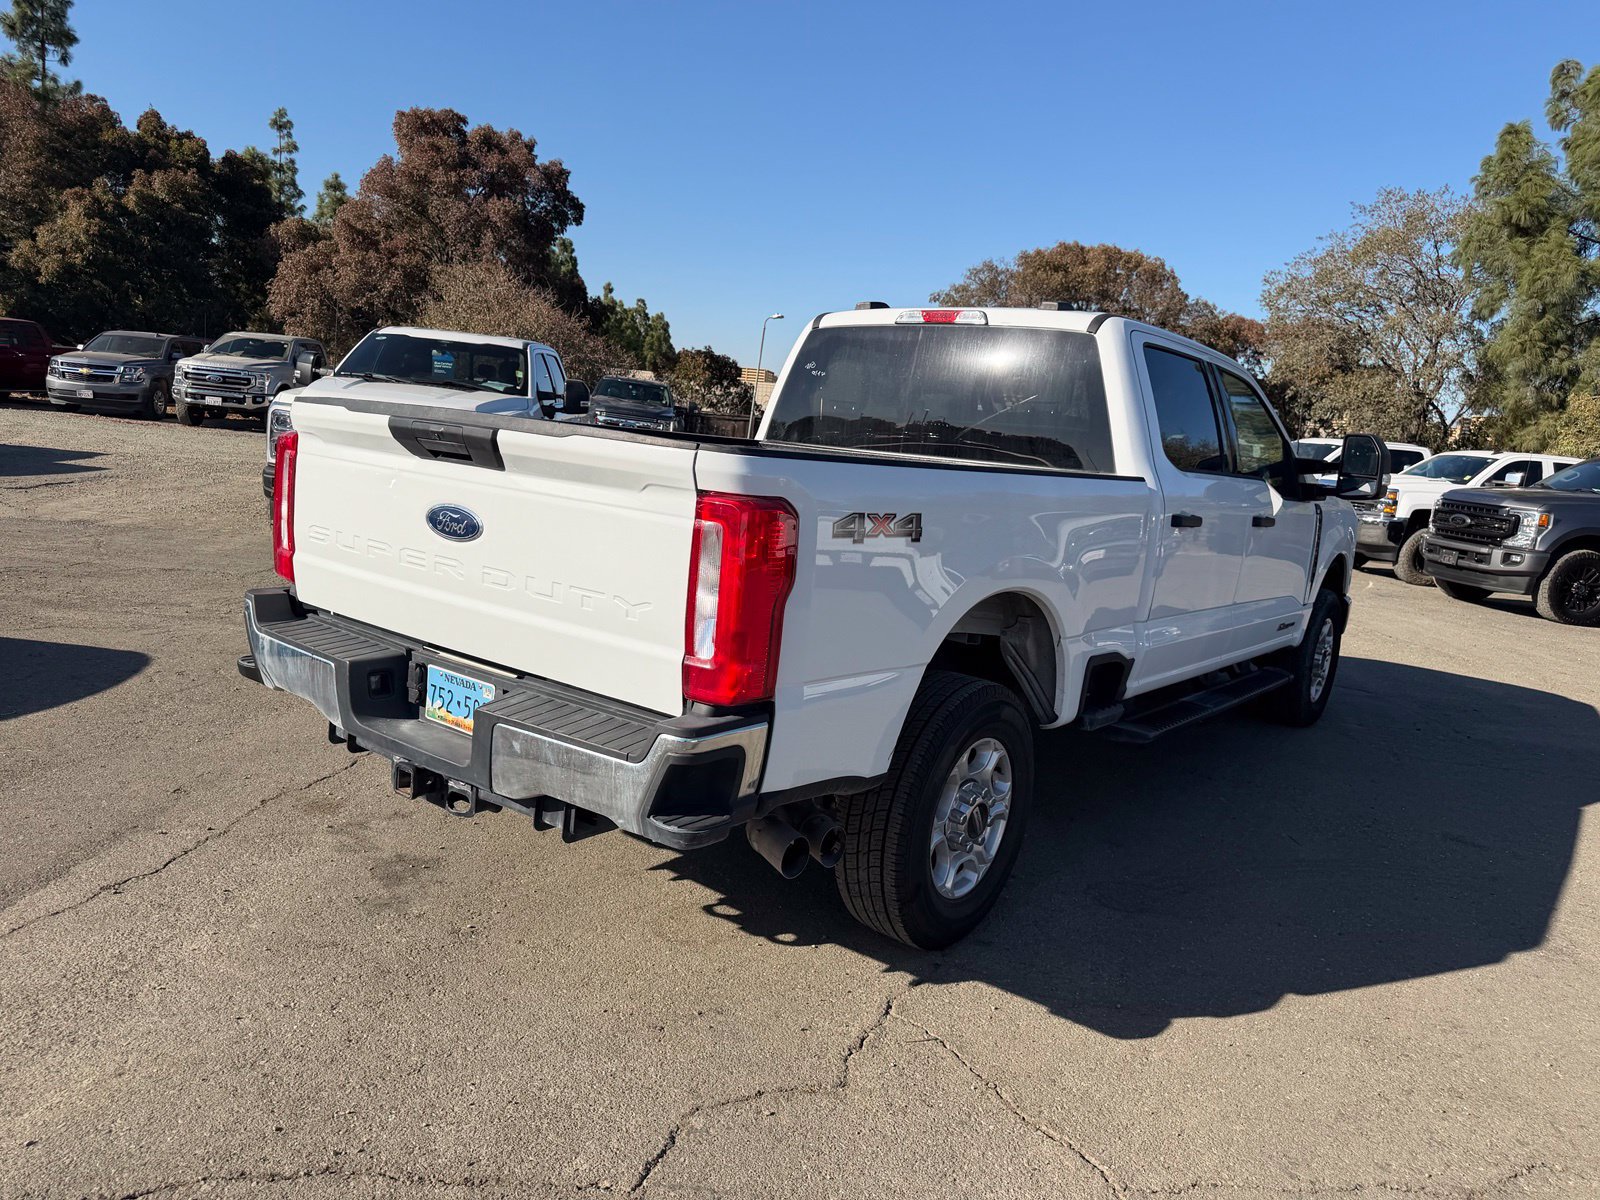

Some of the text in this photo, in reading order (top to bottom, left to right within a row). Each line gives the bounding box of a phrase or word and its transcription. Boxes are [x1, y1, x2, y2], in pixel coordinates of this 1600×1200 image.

[437, 510, 468, 534] Ford
[308, 524, 653, 621] SUPER DUTY
[444, 674, 476, 691] NEVADA
